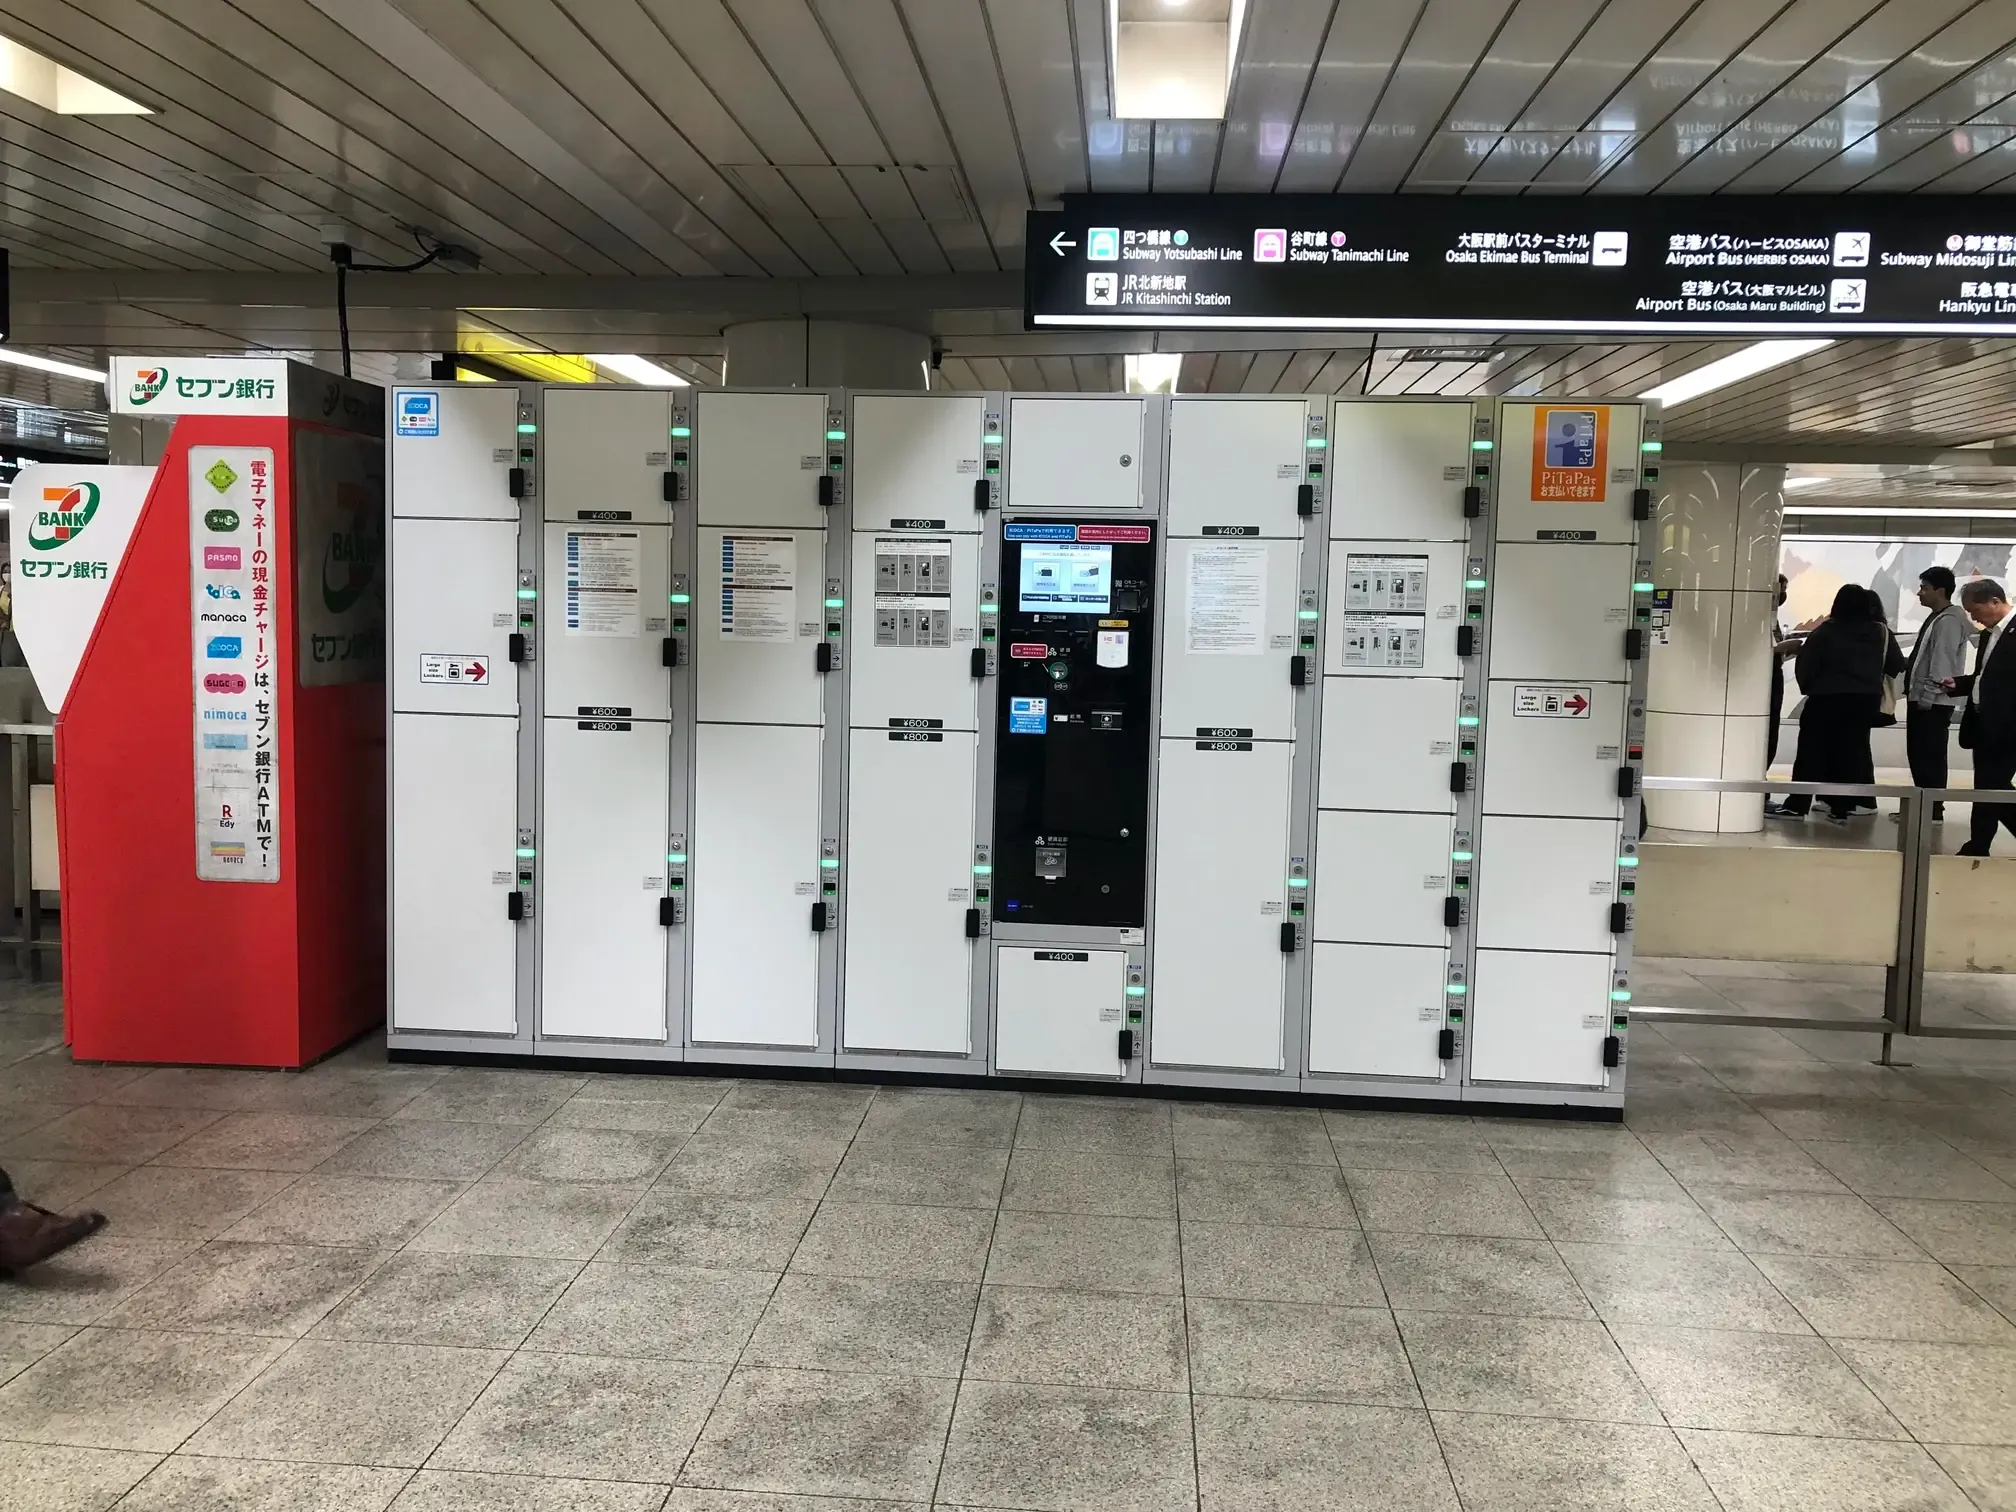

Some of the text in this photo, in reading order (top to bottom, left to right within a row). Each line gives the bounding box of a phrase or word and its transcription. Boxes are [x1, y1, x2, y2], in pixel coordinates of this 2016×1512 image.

[1290, 231, 1328, 247] 谷町線
[1458, 232, 1590, 249] 大阪駅前バスターミナル
[1964, 235, 2016, 252] 御堂筋
[1123, 247, 1243, 262] Subway Yotsubashi Line
[1290, 248, 1409, 264] Subway Tanimachi Line
[1446, 250, 1589, 264] Osaka Ekimae Bus Terminal
[1666, 252, 1830, 267] Airport Bus (HERBIS OSAKA)
[1880, 253, 1933, 268] Subway
[1936, 253, 1994, 269] Midosuji
[1121, 274, 1187, 291] JR北新地駅
[1121, 293, 1231, 305] JR Kitashinchi Station
[1636, 298, 1826, 313] Airport Bus (Osaka Maru Building)
[1939, 300, 1991, 315] Hankyu
[135, 383, 161, 392] BANK
[176, 376, 275, 399] セブン銀行
[1578, 414, 1594, 465] PiTaPa
[1541, 471, 1597, 485] PiTaPaで
[1540, 486, 1597, 497] お支払いできます
[39, 511, 86, 527] BANK
[905, 520, 931, 529] ¥400
[1217, 527, 1244, 536] ¥400
[207, 553, 238, 562] PASMO
[20, 559, 108, 579] セブン銀行
[201, 613, 247, 622] manaca
[204, 708, 247, 720] nimoca
[592, 708, 617, 716] ¥600
[903, 719, 929, 728] ¥600
[903, 733, 929, 742] ¥800
[1211, 728, 1238, 737] ¥600
[1210, 742, 1238, 751] ¥800
[220, 820, 235, 829] Edy
[1049, 952, 1075, 961] ¥400
